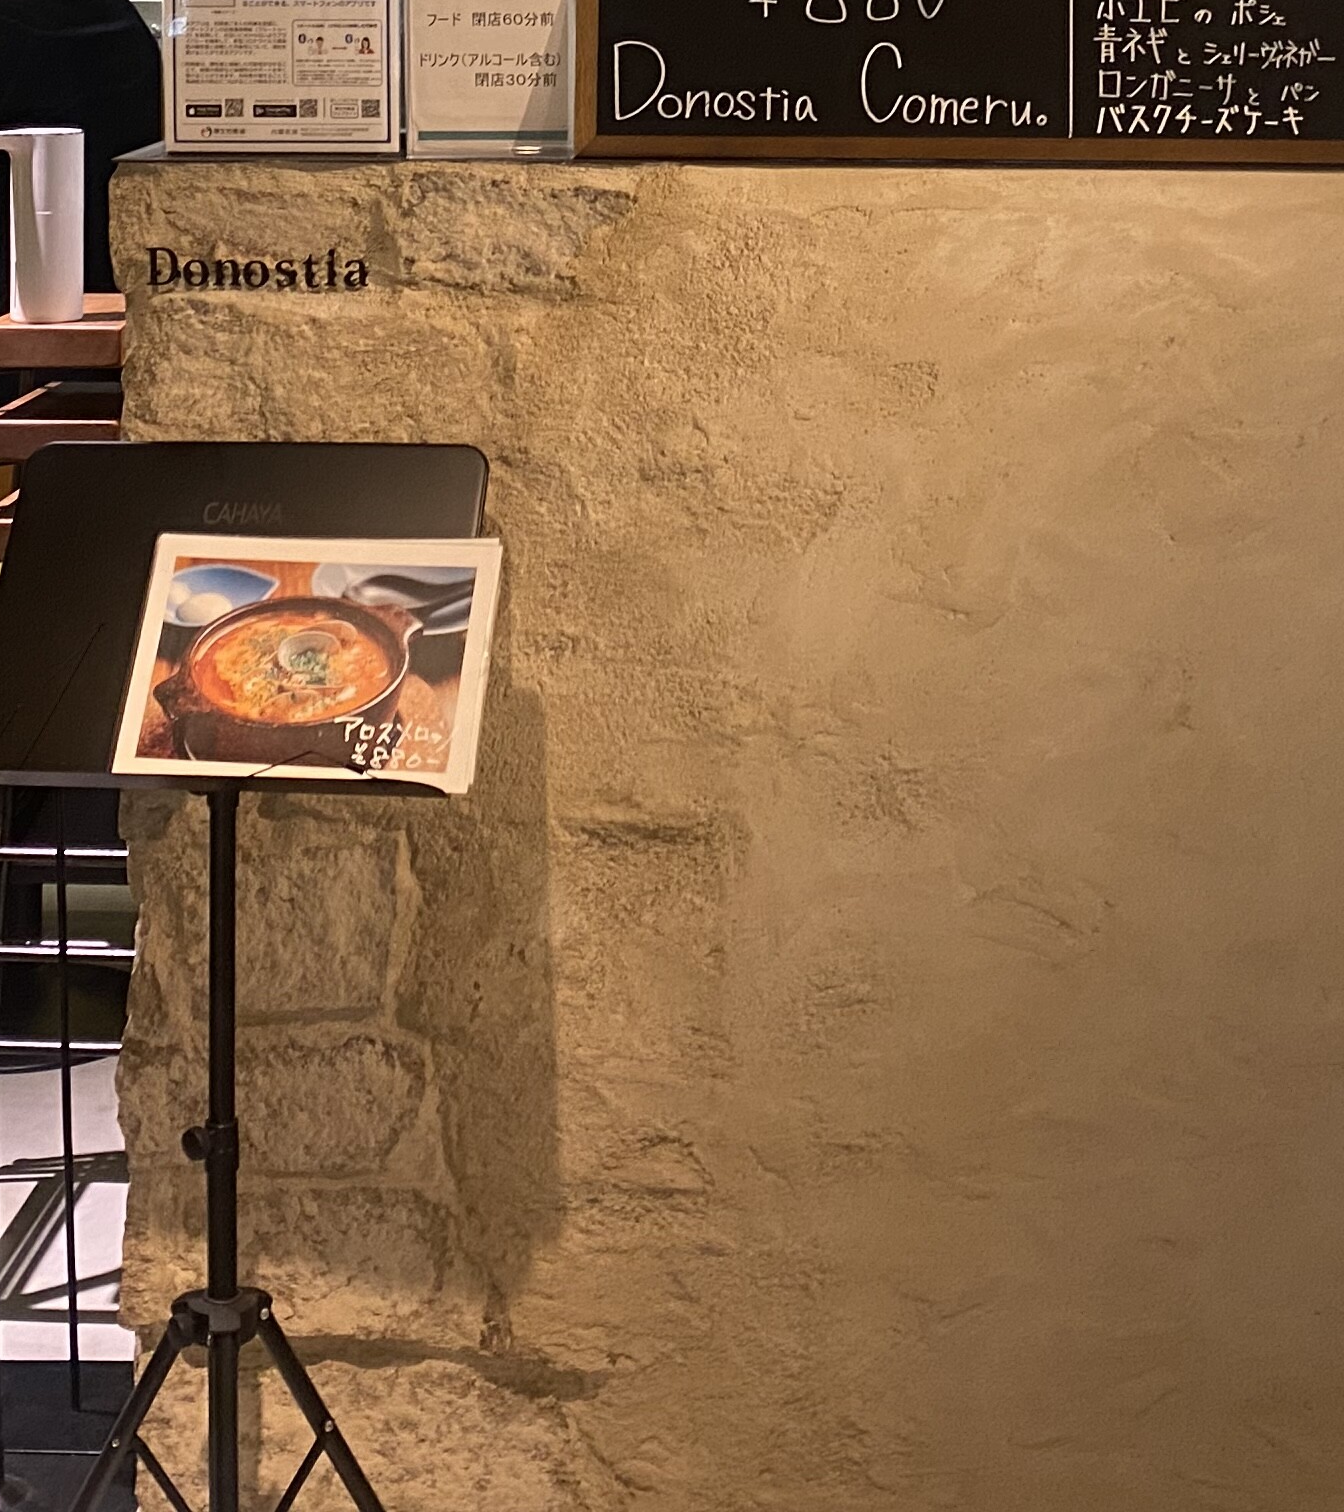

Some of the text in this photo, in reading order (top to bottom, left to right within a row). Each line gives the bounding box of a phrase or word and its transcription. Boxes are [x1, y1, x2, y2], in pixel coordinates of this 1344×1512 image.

[426, 11, 555, 27] フード 閉店60分前
[474, 72, 557, 88] 閉店30分前
[613, 40, 818, 121] Donostia
[1095, 104, 1305, 136] バスクチーズケーキ
[145, 246, 370, 289] Donostia
[203, 501, 281, 525] CAHAYA
